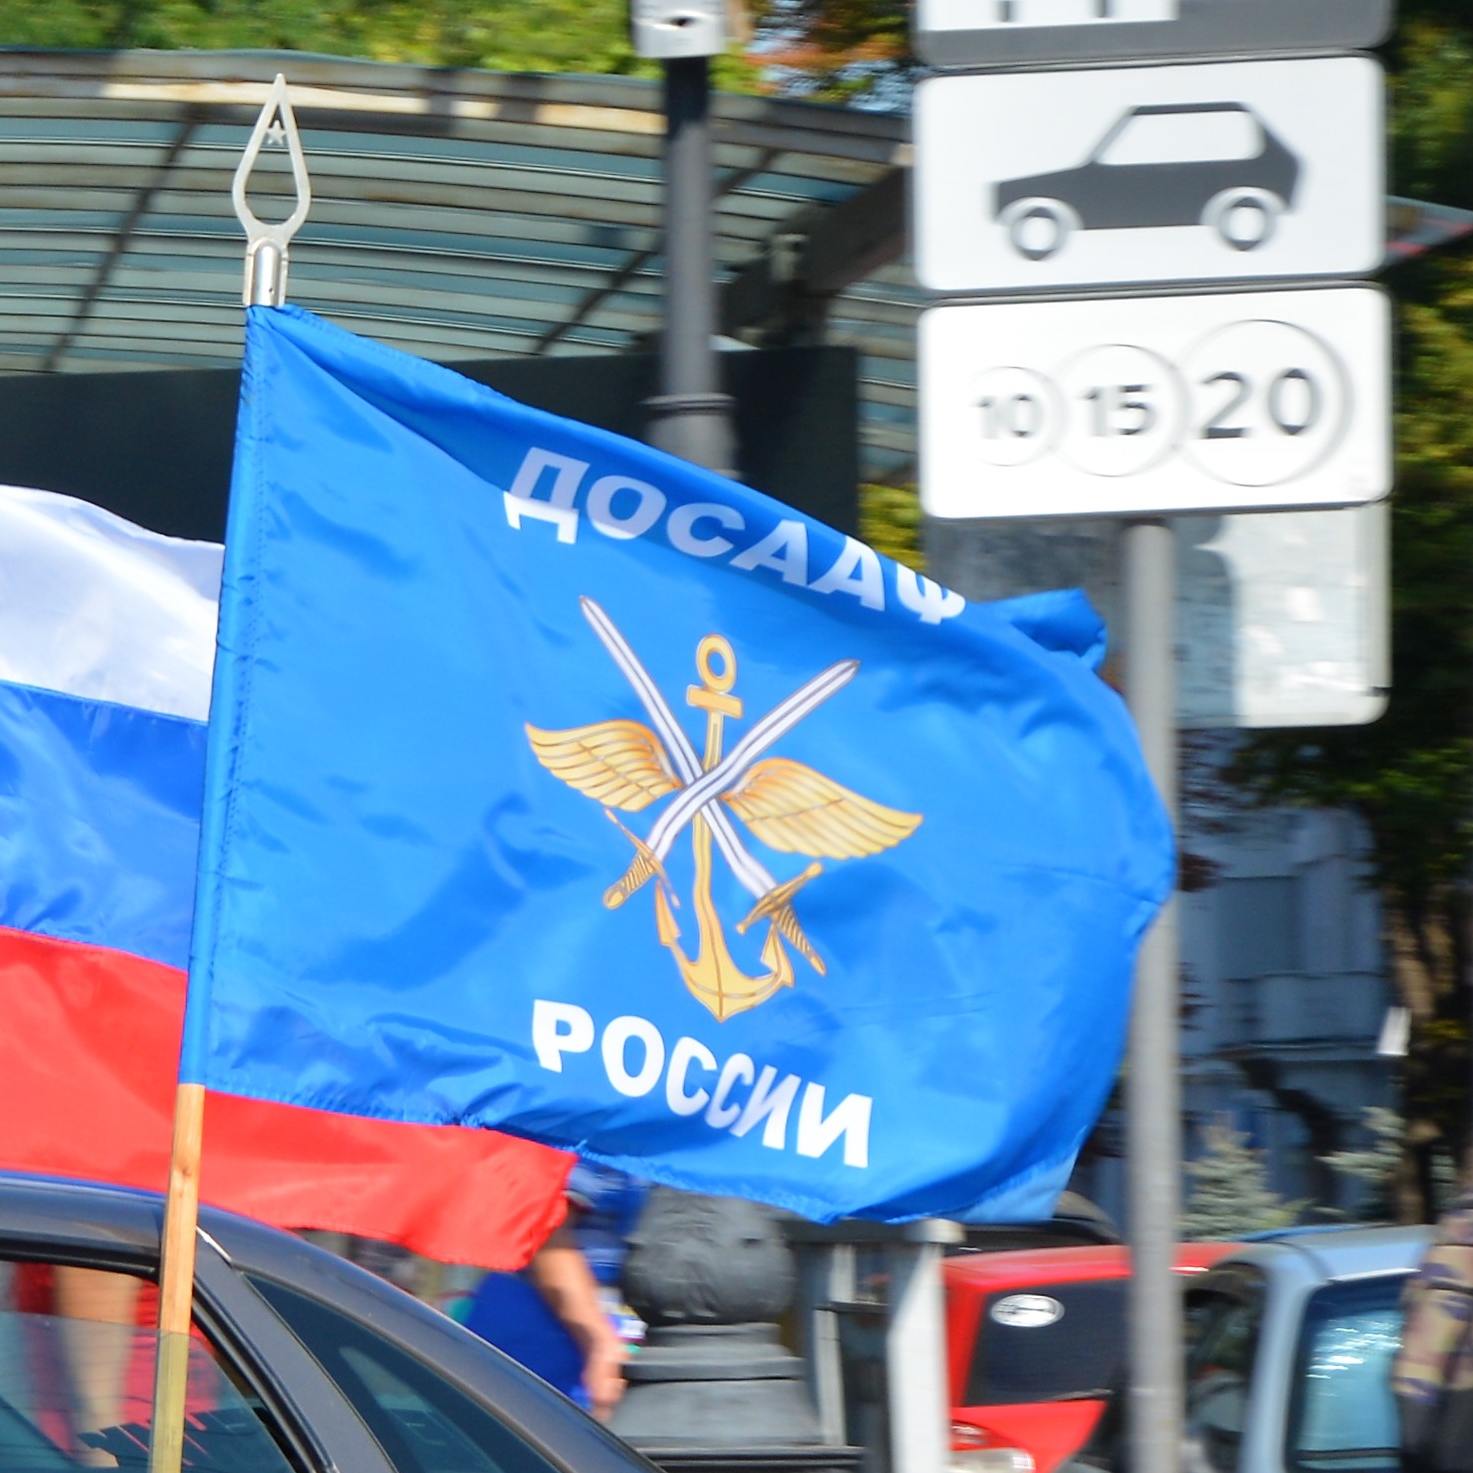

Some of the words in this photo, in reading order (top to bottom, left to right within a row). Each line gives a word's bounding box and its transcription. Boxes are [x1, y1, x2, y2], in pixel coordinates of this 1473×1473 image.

[977, 395, 1044, 441] 10
[1082, 382, 1154, 438] 15
[1199, 368, 1320, 439] 20
[531, 998, 874, 1168] РОССИИ
